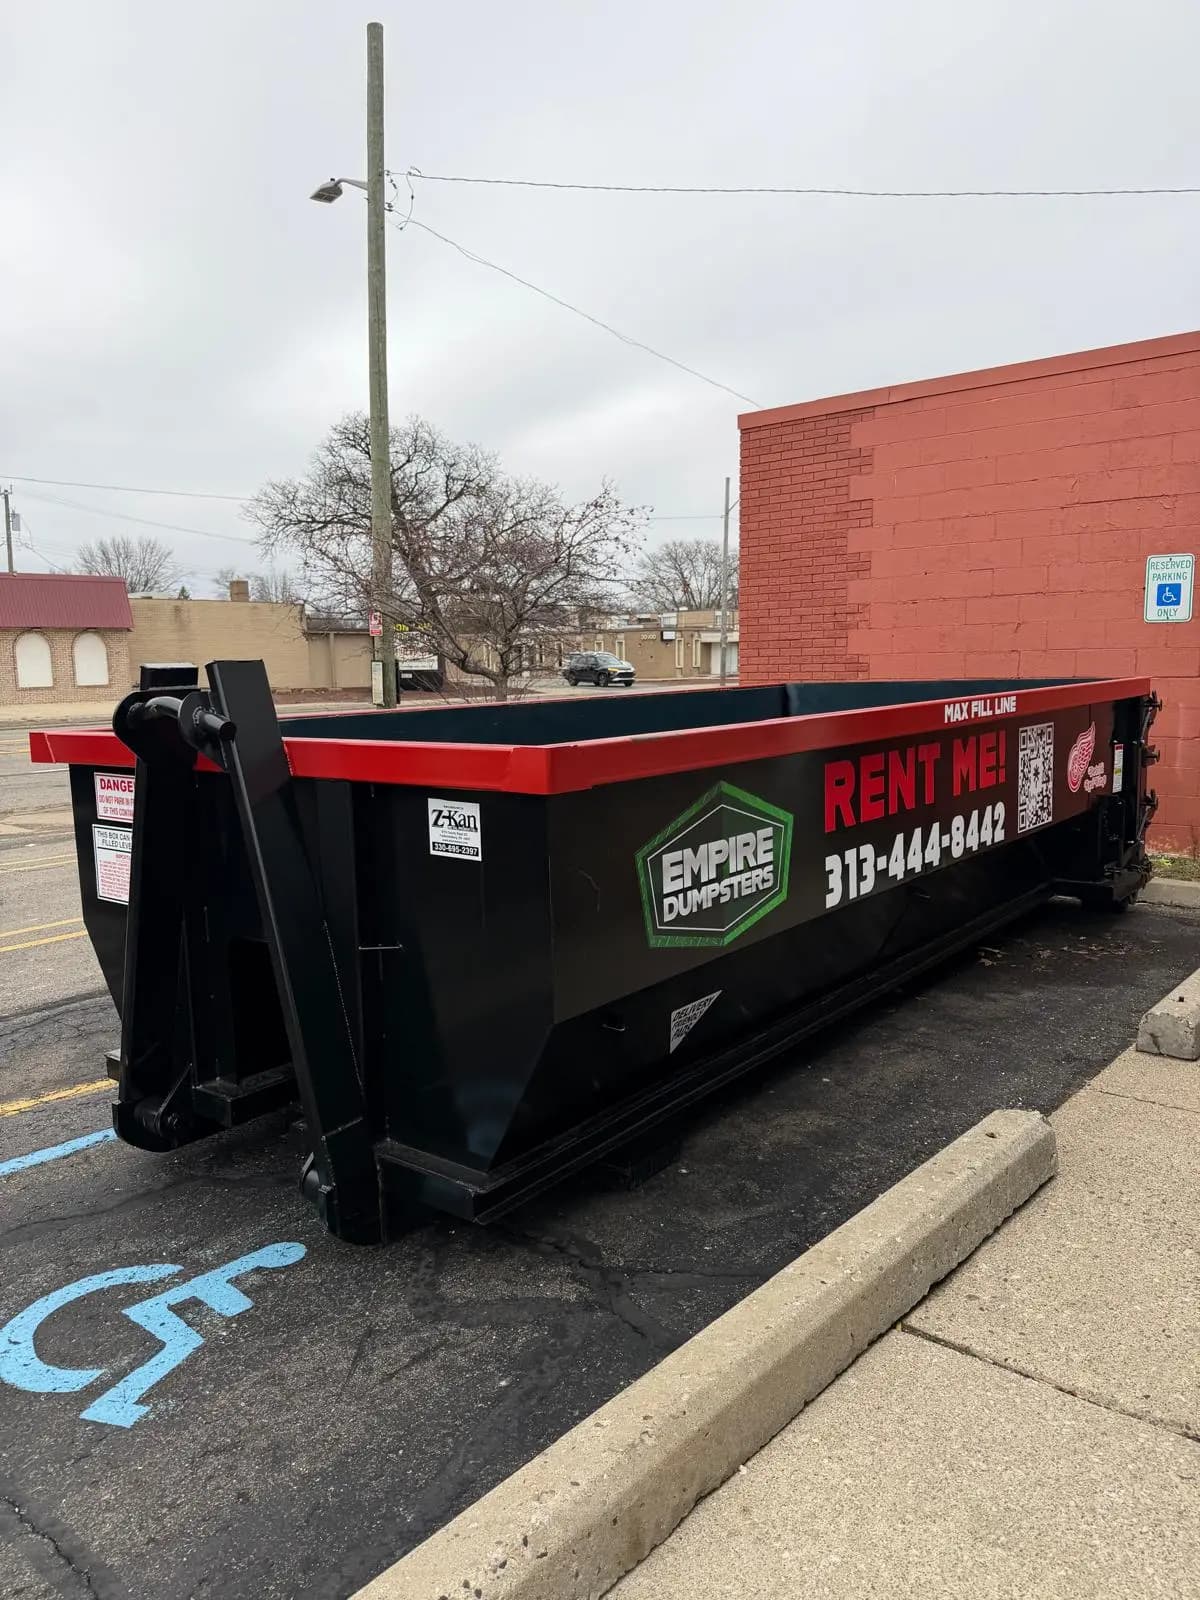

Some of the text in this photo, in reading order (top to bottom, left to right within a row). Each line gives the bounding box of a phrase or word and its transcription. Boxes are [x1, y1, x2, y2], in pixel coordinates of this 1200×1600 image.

[1151, 560, 1191, 570] RESERVED
[1152, 571, 1188, 581] PARKING
[1157, 608, 1178, 617] ONLY
[944, 696, 1017, 724] MAX FILL LINE
[100, 778, 134, 793] DANGE
[824, 730, 1006, 833] RENT ME!
[432, 809, 478, 832] Z-Kan
[97, 831, 108, 839] THIS
[108, 832, 118, 840] BOX
[102, 840, 132, 849] FILLED LEVE
[662, 826, 774, 895] EMPIRE
[825, 801, 1006, 909] 313-444-8442
[663, 864, 774, 923] DUMPSTERS
